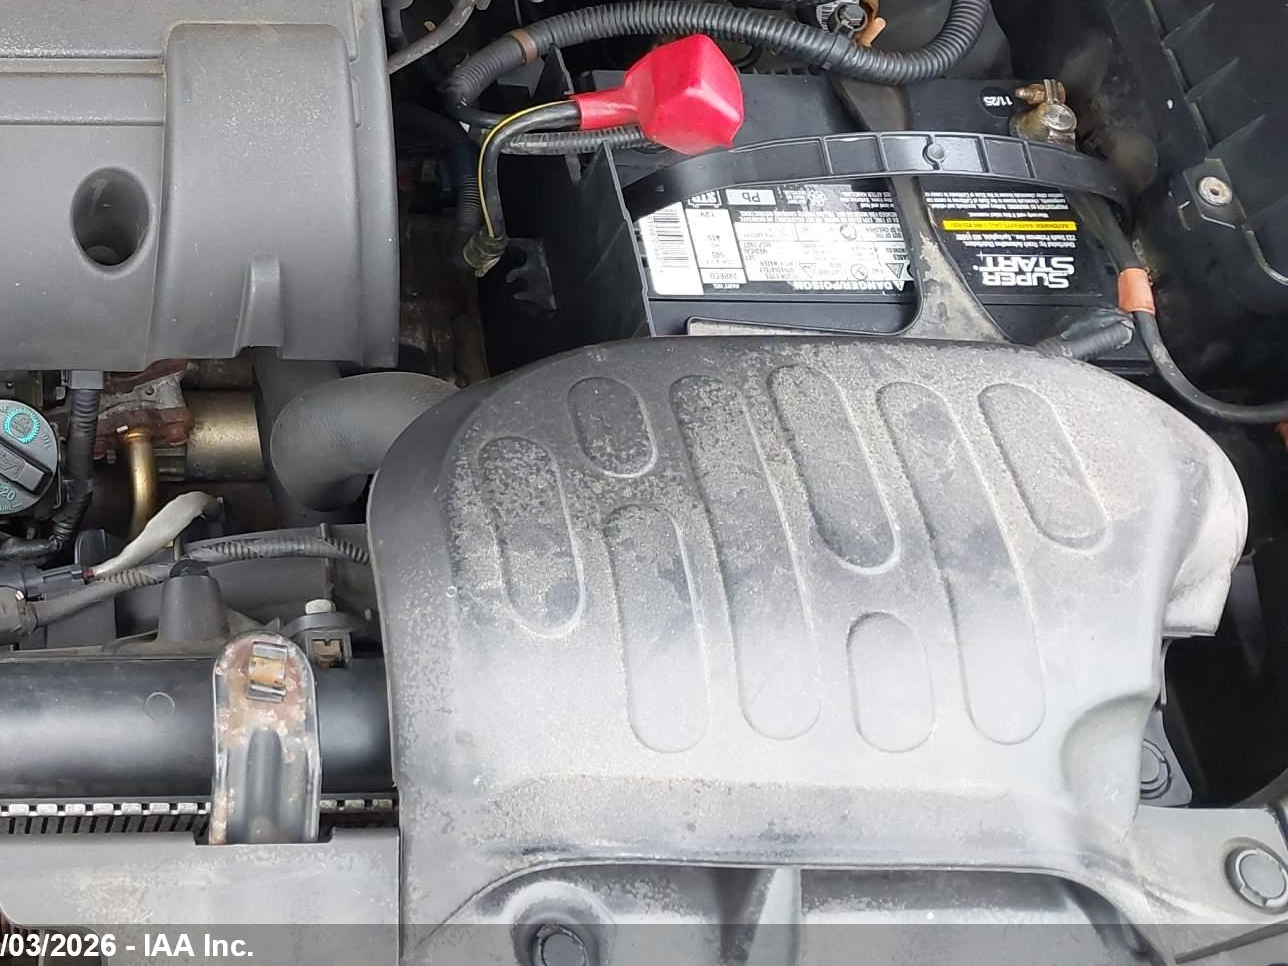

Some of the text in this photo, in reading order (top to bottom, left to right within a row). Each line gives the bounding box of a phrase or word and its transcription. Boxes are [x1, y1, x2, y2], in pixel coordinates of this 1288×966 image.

[983, 96, 1013, 106] 11/25
[741, 191, 760, 203] Pb
[979, 257, 1073, 275] START
[982, 271, 1070, 289] SUPER
